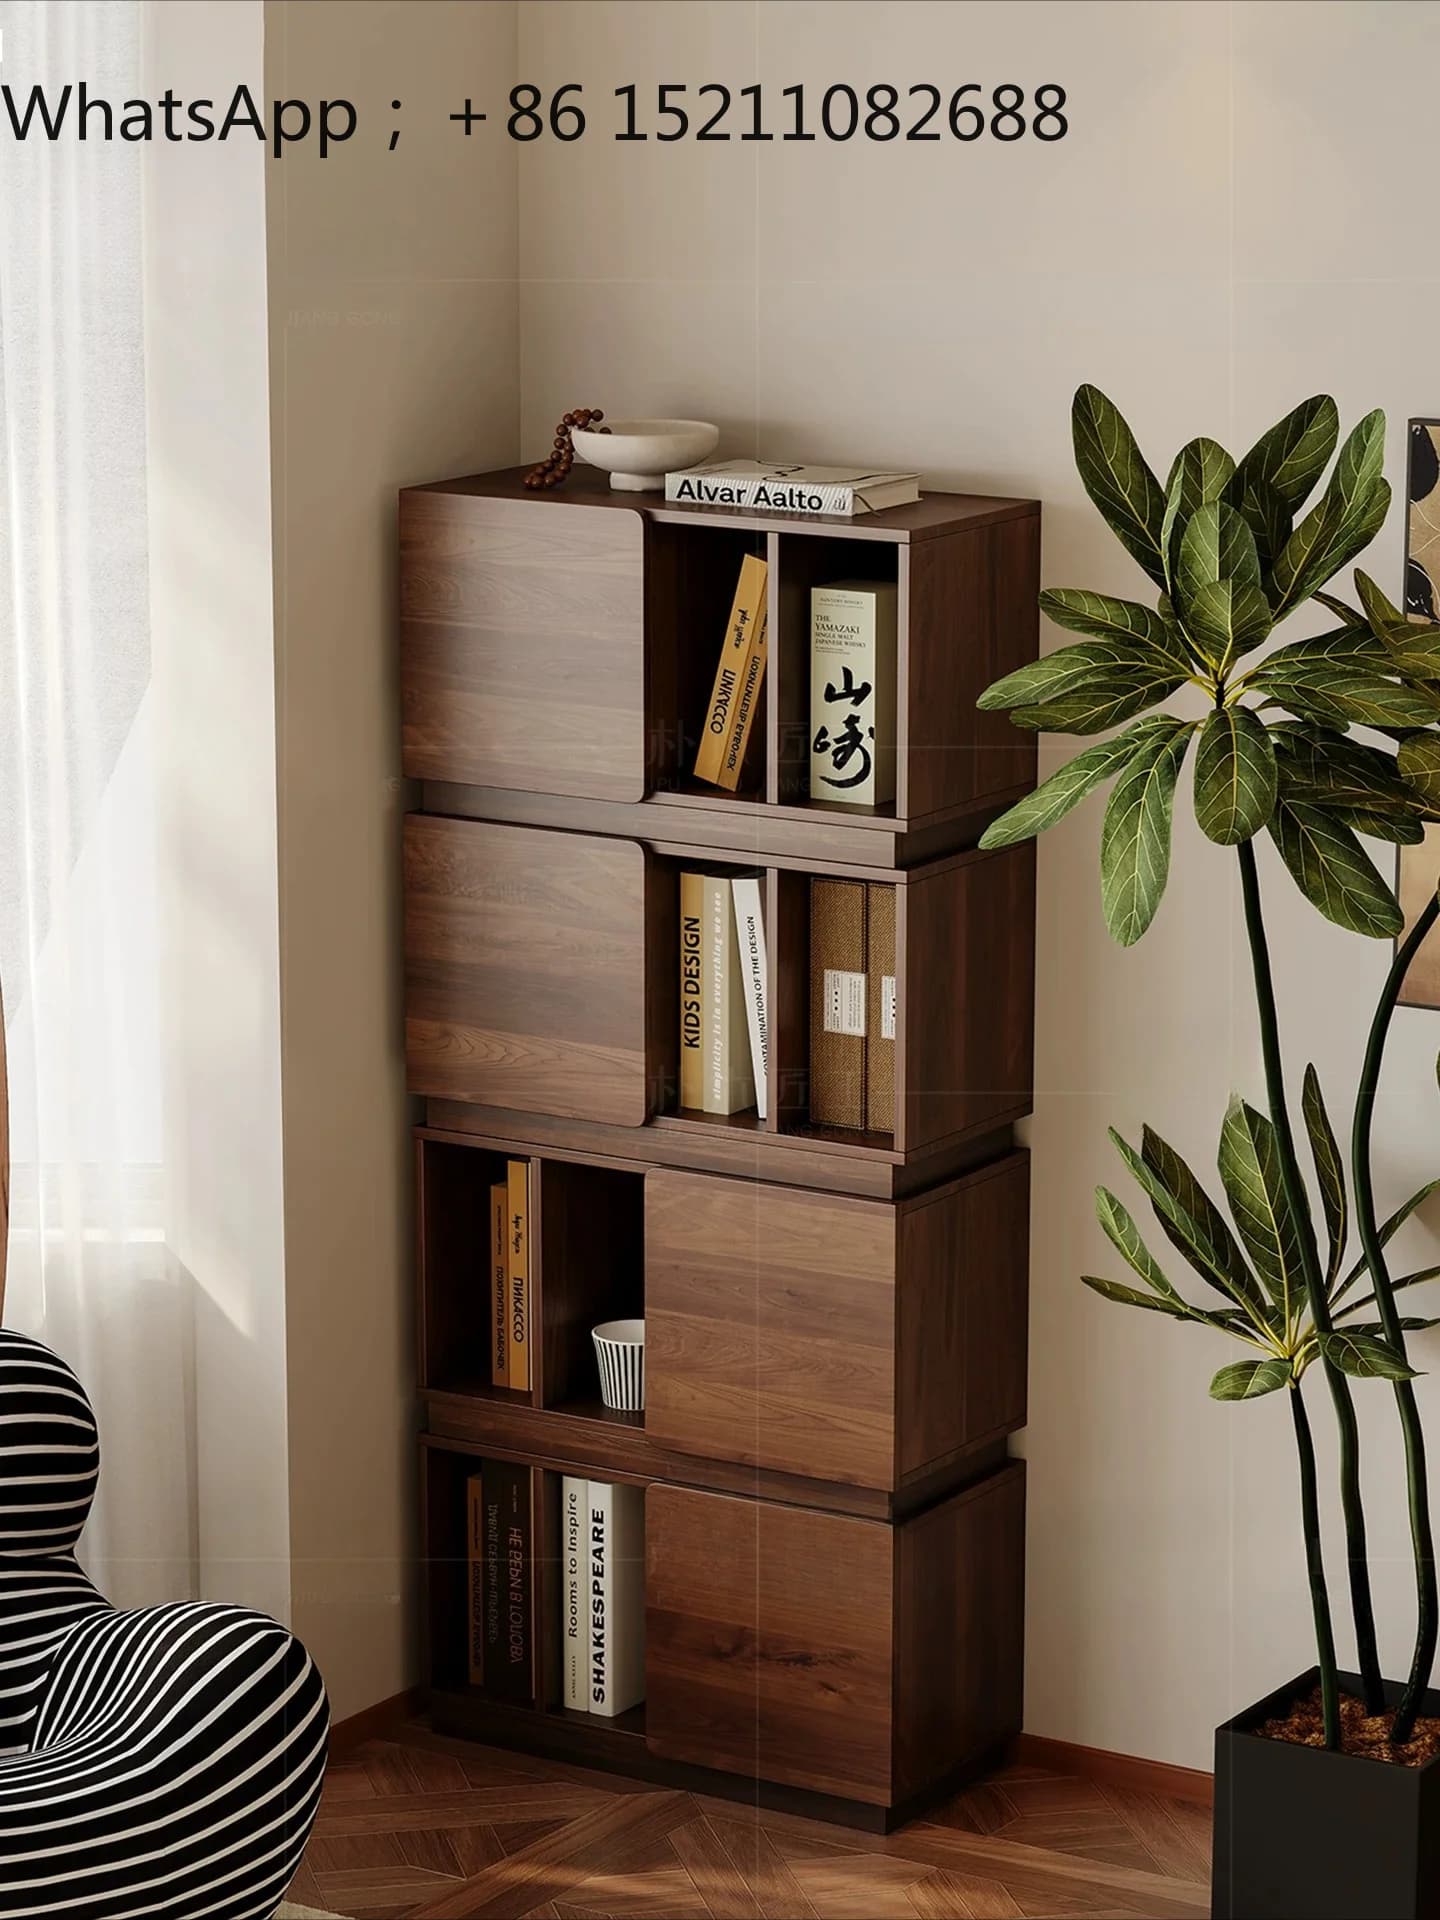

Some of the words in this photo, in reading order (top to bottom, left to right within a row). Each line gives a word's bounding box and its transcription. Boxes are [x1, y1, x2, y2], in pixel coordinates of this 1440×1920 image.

[676, 479, 747, 504] Alvar
[753, 485, 824, 511] Aalto
[815, 614, 832, 622] THE
[815, 622, 860, 634] YAMAZAKI
[712, 891, 722, 913] see
[712, 916, 722, 934] we
[747, 916, 758, 954] DESIGN
[684, 916, 701, 992] DESIGN
[750, 955, 760, 975] THE
[711, 937, 724, 1004] everything
[753, 976, 763, 991] OF
[683, 994, 701, 1049] KIDS
[711, 1008, 722, 1020] in
[711, 1024, 722, 1035] is
[711, 1037, 725, 1100] simplicity
[513, 1277, 524, 1343] ПИКАССО
[567, 1492, 580, 1552] Inspire
[567, 1557, 578, 1575] to
[567, 1580, 578, 1638] Rooms
[591, 1508, 606, 1704] SHAKESPEARE
